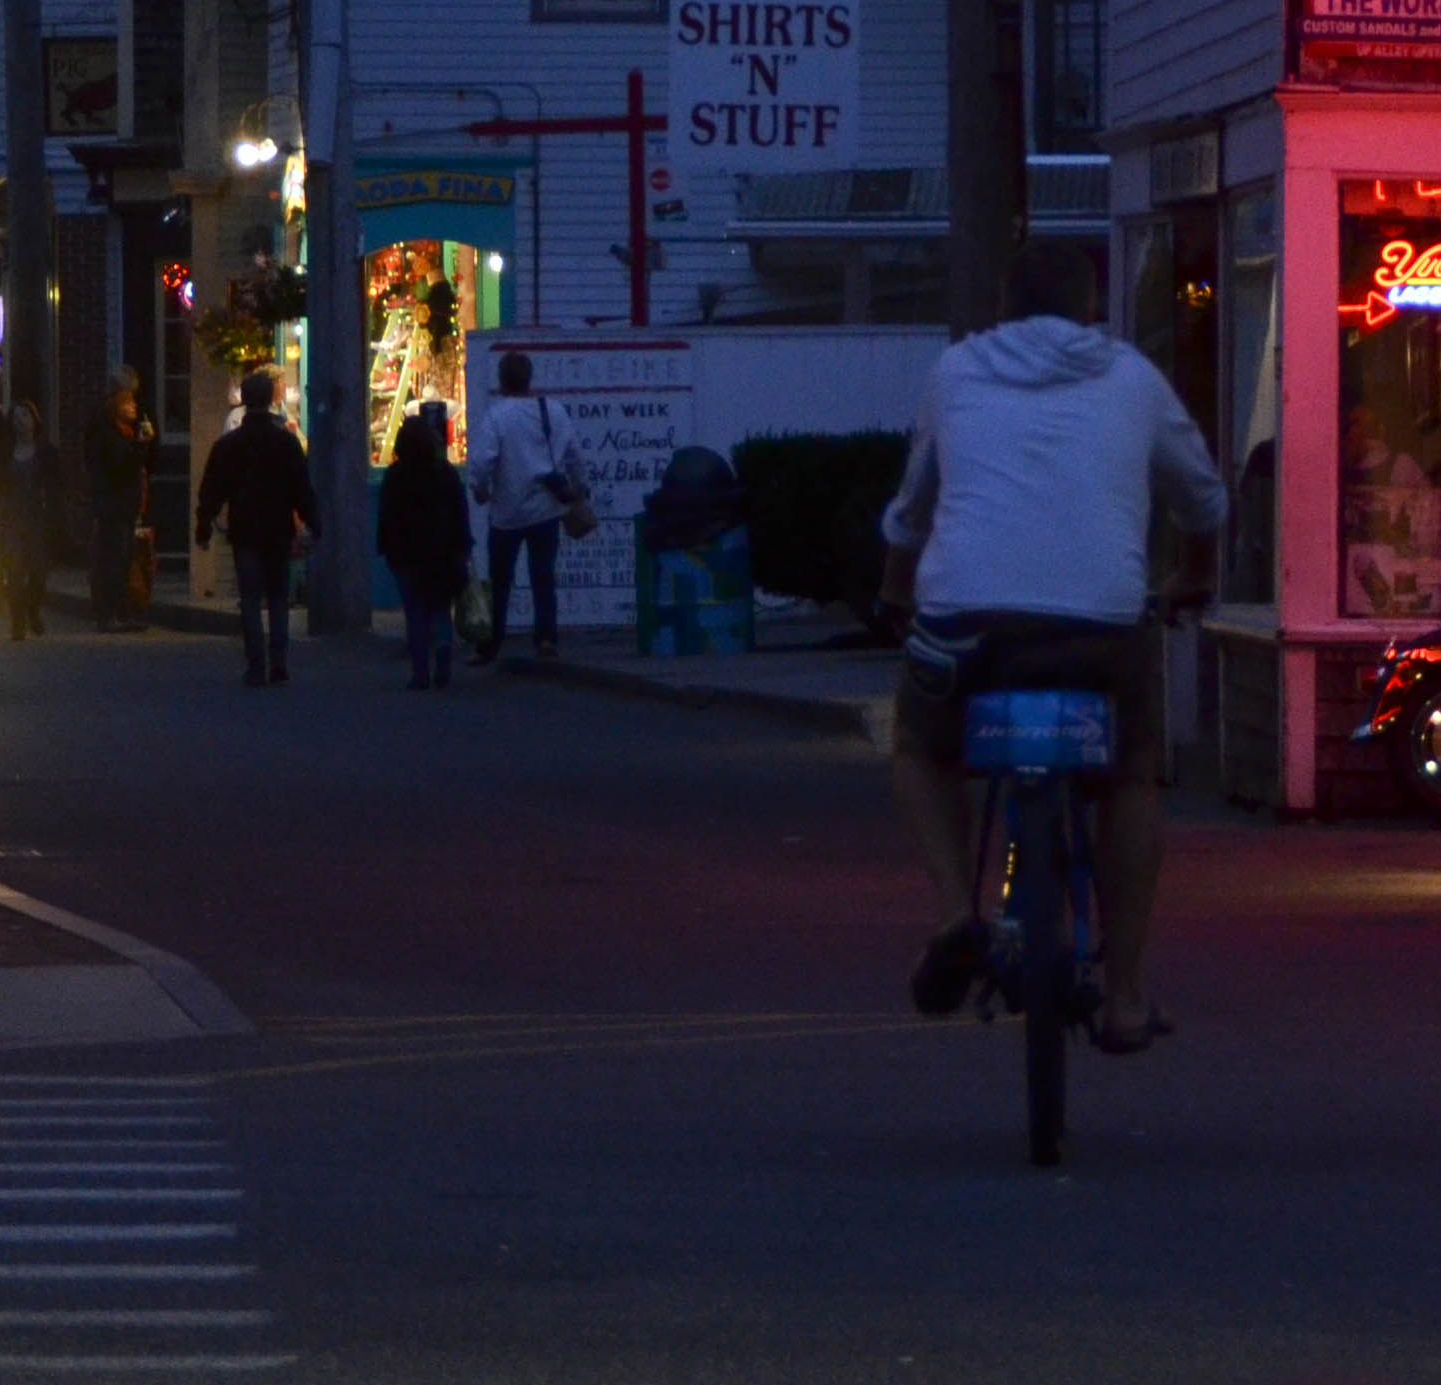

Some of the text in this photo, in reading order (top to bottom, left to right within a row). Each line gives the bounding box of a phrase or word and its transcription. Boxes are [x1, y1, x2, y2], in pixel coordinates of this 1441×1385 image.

[677, 0, 852, 49] SHIRTS
[1303, 20, 1355, 35] CUSTOM
[1359, 22, 1416, 36] SANDALS
[690, 104, 841, 150] STUFF
[580, 404, 610, 419] DAY
[620, 403, 670, 418] WEEK
[598, 421, 677, 452] National
